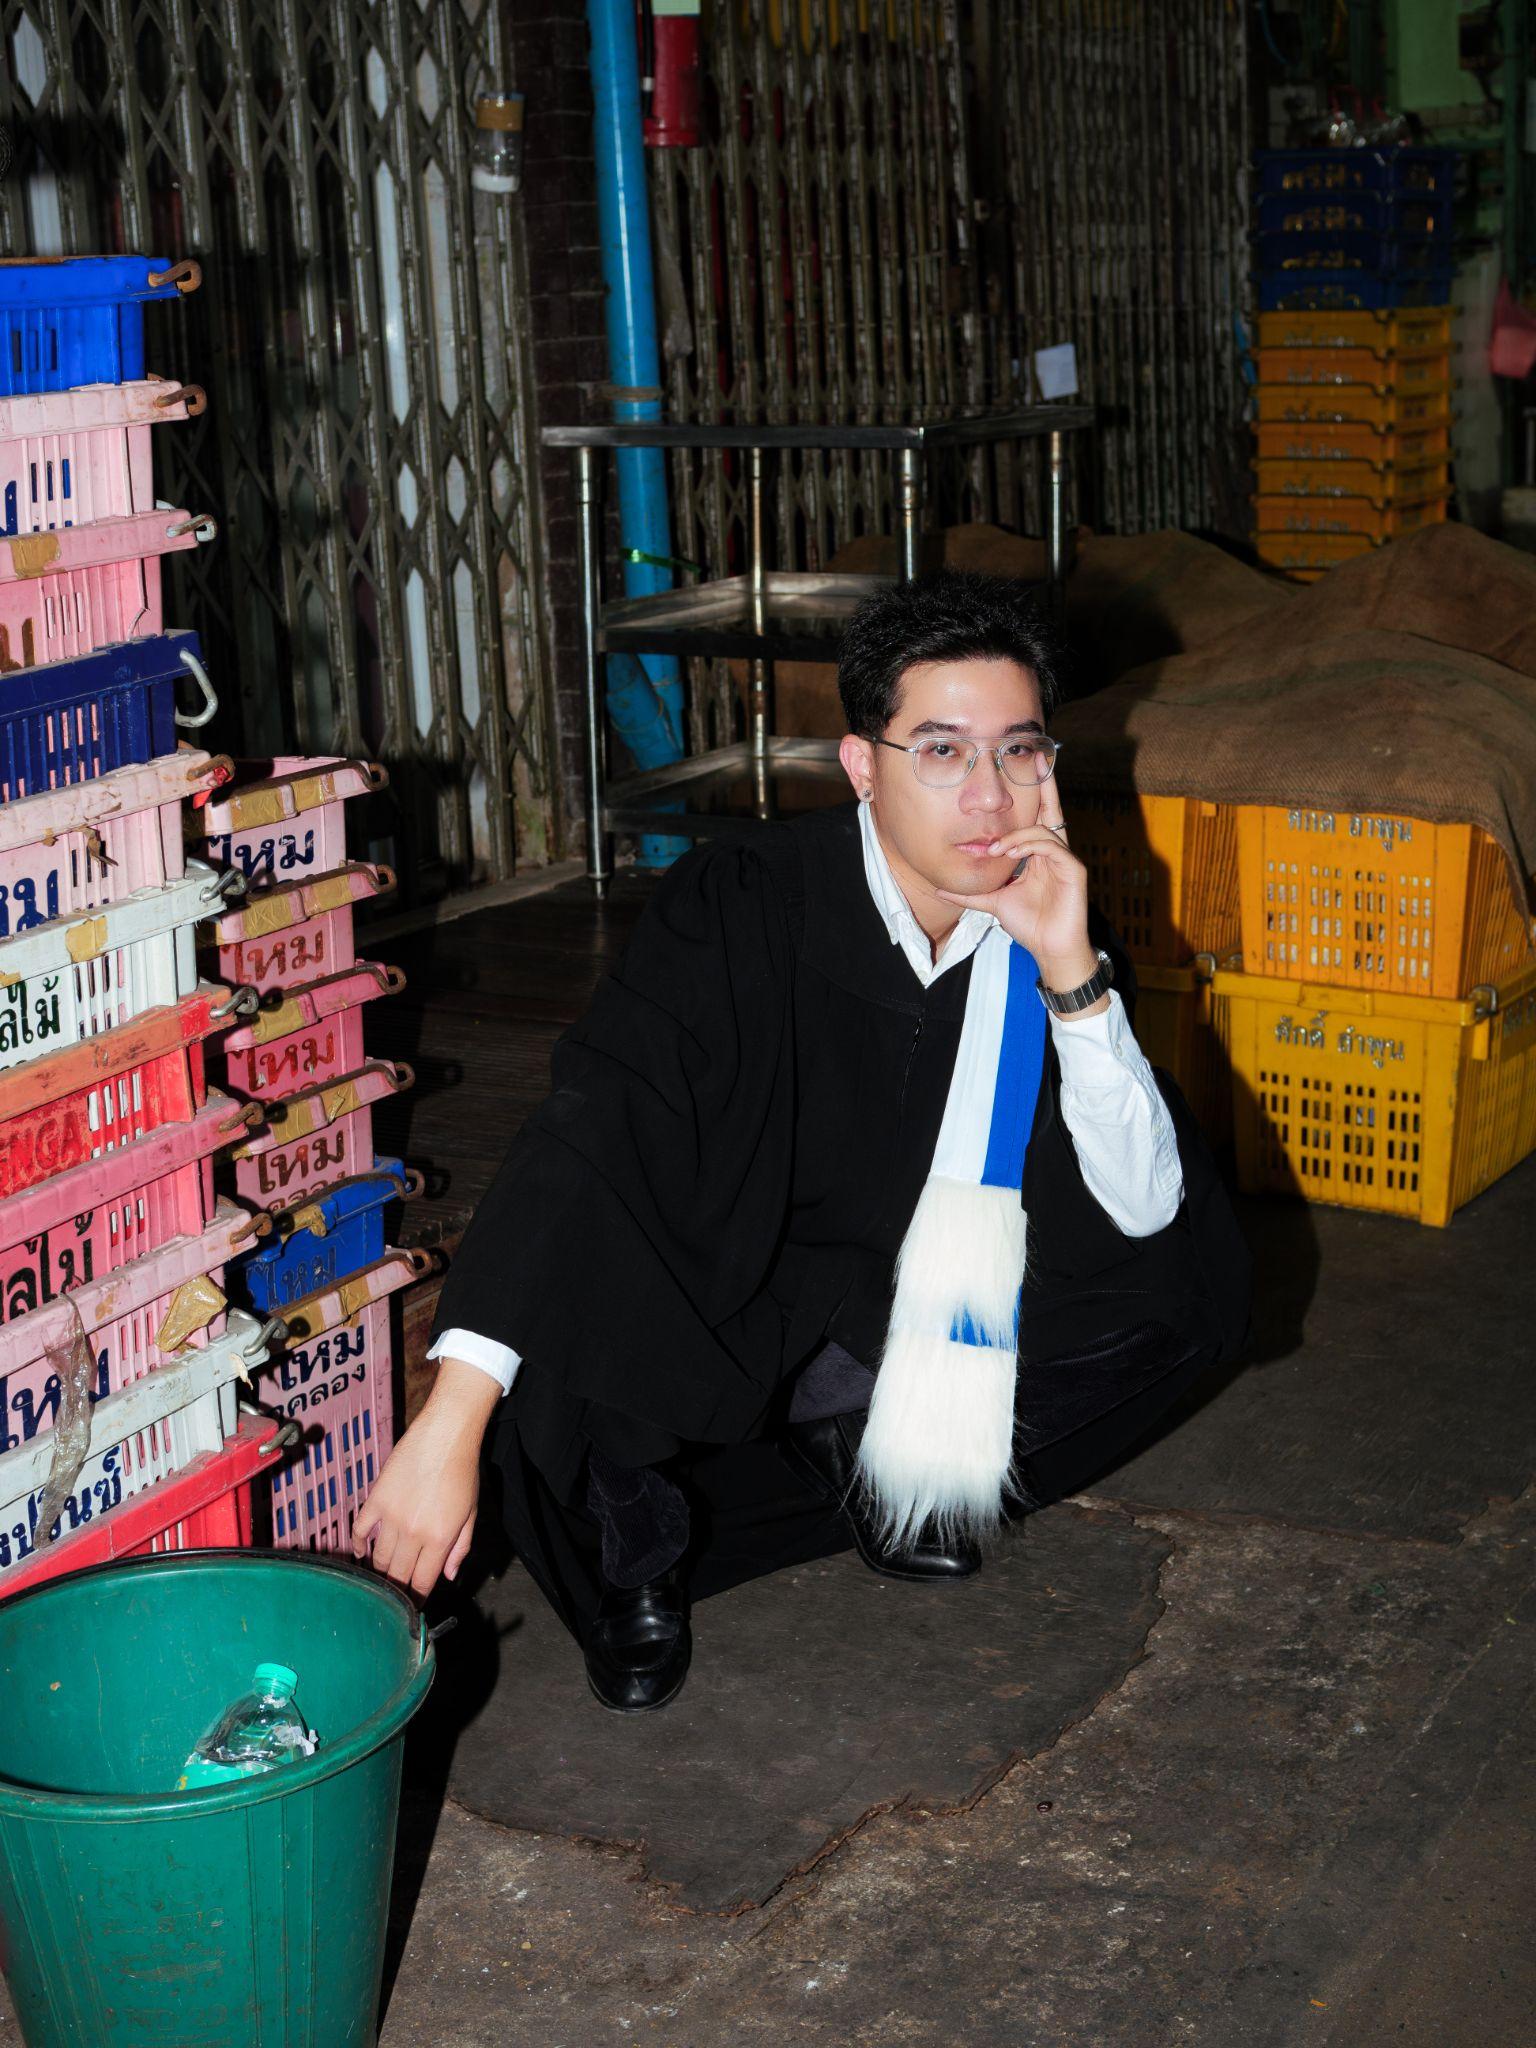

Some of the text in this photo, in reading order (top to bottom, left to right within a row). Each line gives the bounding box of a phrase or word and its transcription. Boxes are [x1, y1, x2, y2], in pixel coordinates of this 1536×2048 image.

[220, 930, 324, 985] ไหม
[230, 1030, 336, 1092] ไหม
[246, 1130, 345, 1195] ไหม
